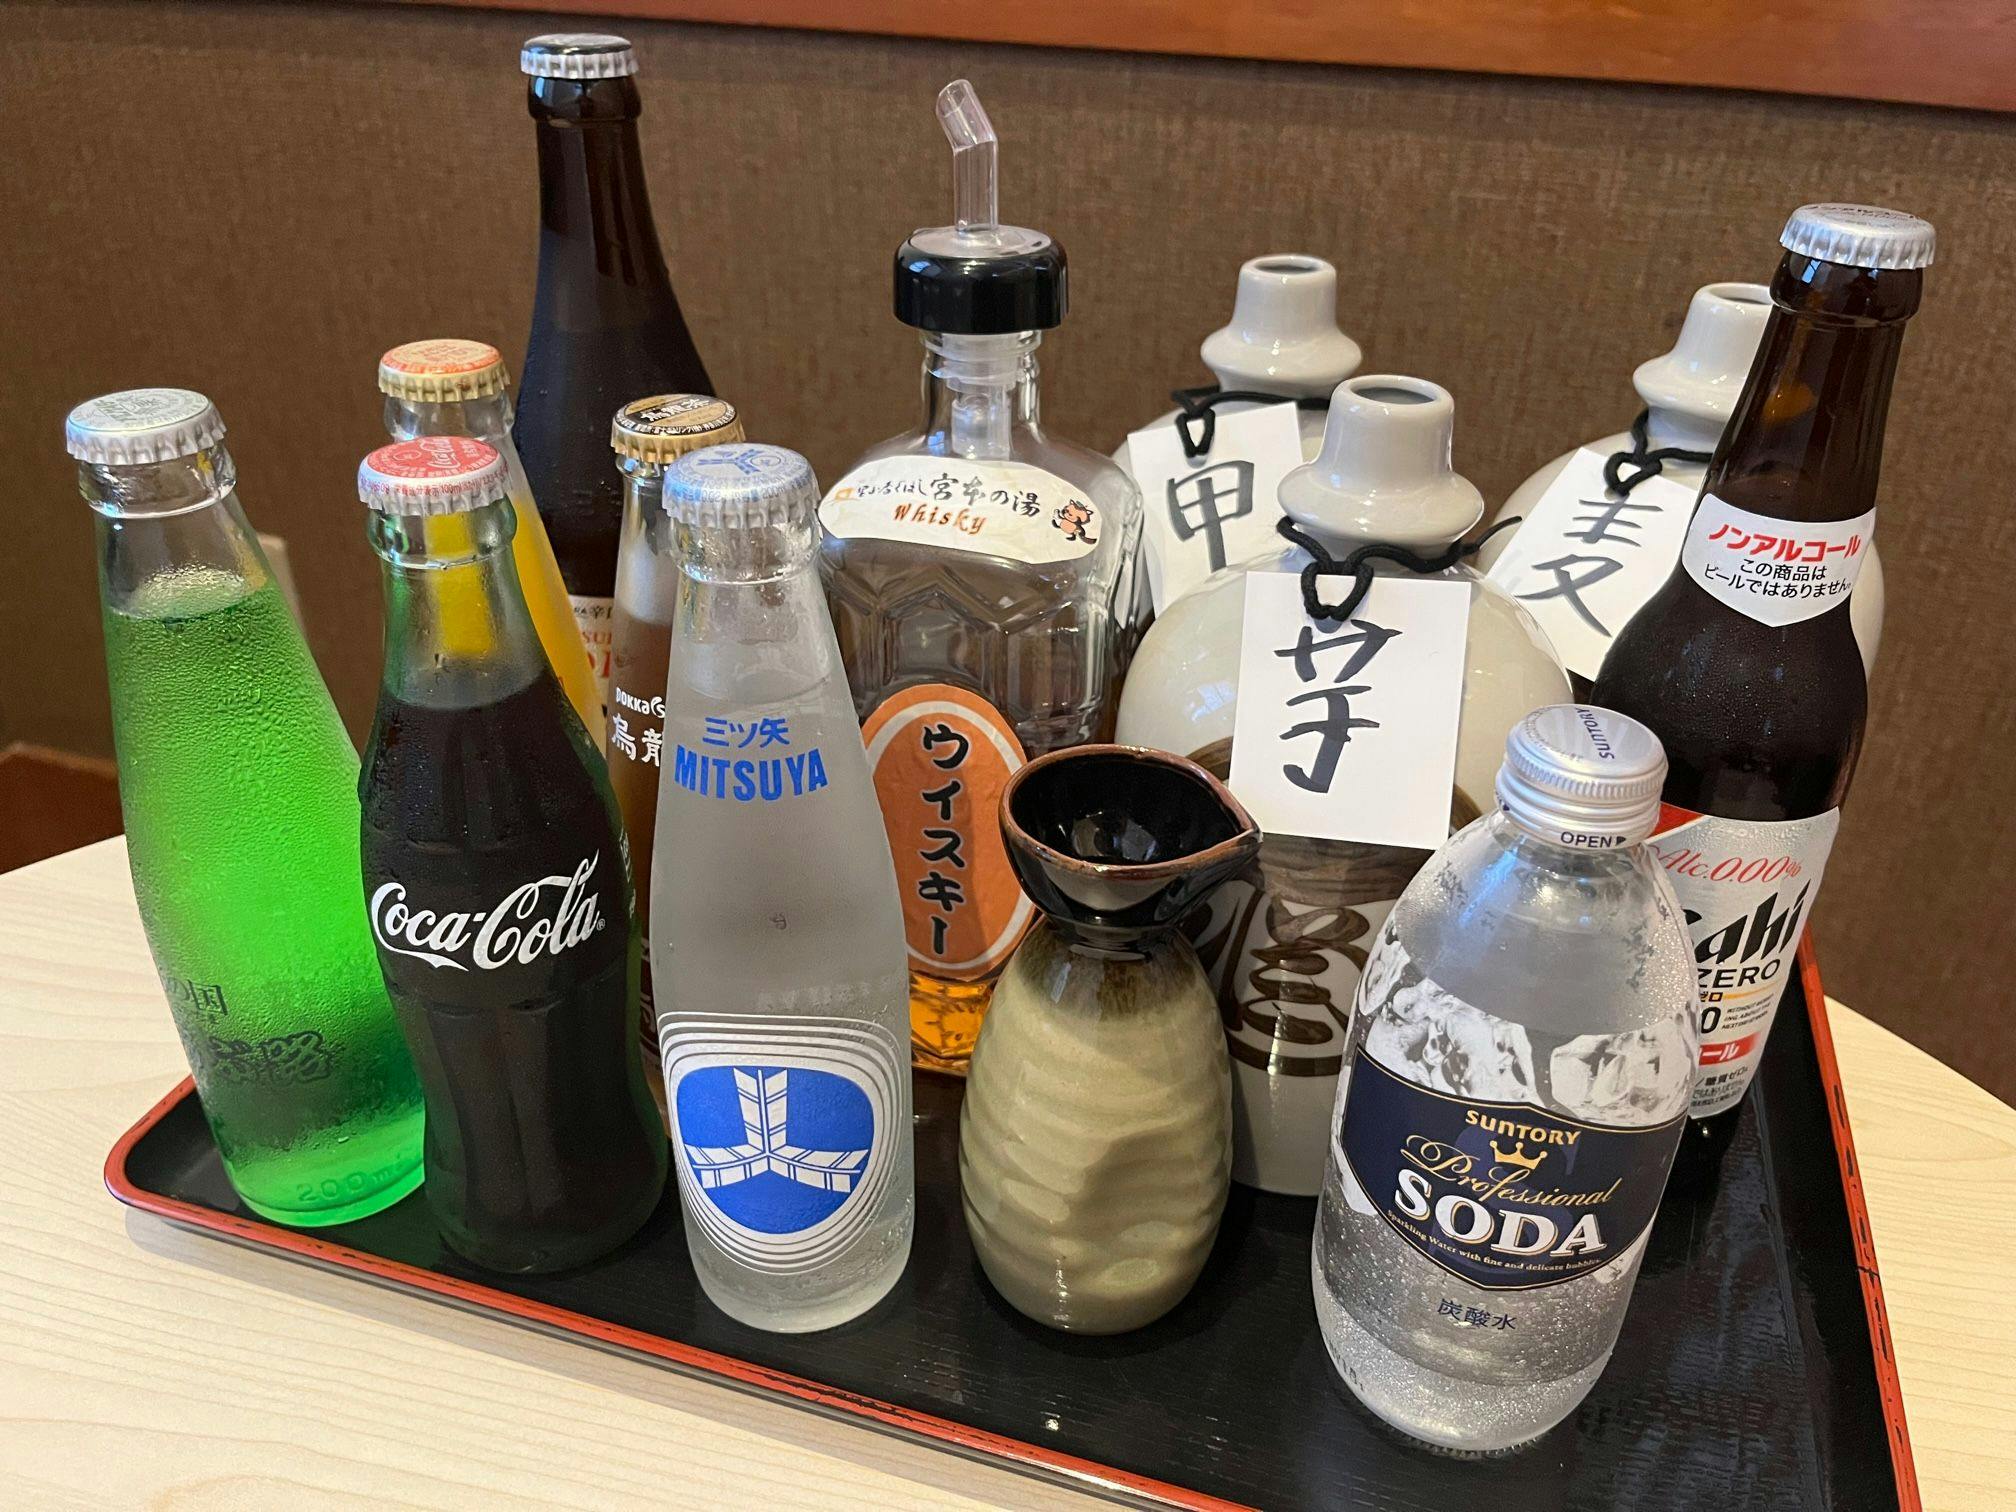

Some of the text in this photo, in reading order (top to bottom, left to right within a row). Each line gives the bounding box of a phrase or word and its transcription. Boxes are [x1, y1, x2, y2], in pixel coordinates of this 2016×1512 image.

[892, 503, 988, 536] Whisky
[1166, 460, 1255, 572] 甲
[1708, 523, 1862, 563] ノンアルコール
[1514, 494, 1664, 638] 麦
[1740, 558, 1827, 582] この商品は
[702, 717, 790, 750] 三ツ矢
[674, 743, 829, 802] MITSUYA
[919, 723, 970, 956] ウイスキー
[1560, 831, 1613, 848] OPEN
[371, 849, 601, 972] Coca-Cola
[1682, 879, 1812, 965] ahi
[1465, 1109, 1582, 1146] SUNTORY
[1400, 1134, 1623, 1206] Professional
[1387, 1209, 1427, 1241] Sparkling
[1429, 1234, 1457, 1253] Water
[1459, 1249, 1481, 1262] with
[1483, 1255, 1503, 1267] fine
[1504, 1261, 1524, 1271] and
[1526, 1261, 1564, 1272] delicate
[1394, 1168, 1608, 1258] SODA
[1437, 1298, 1518, 1331] 炭酸水
